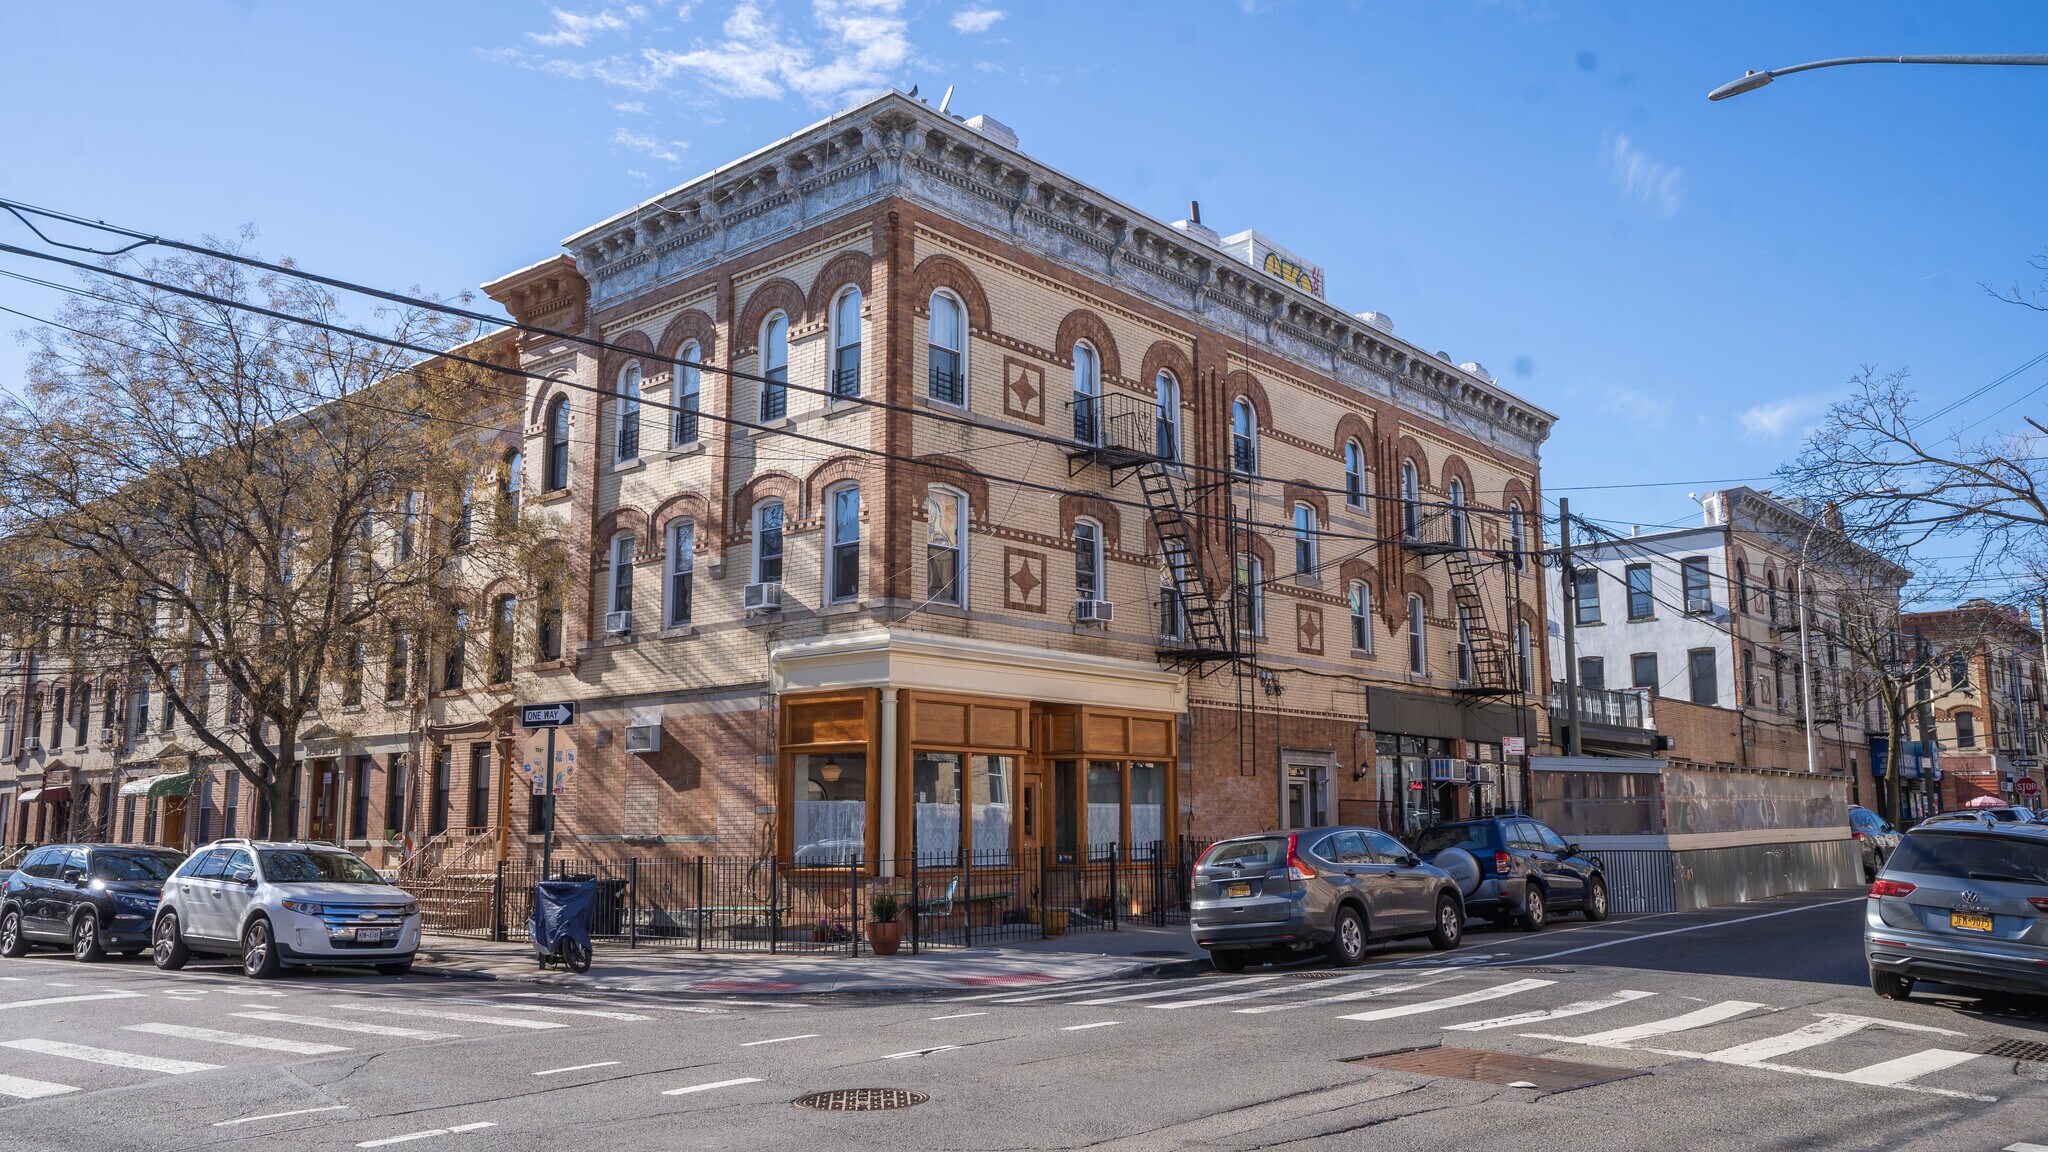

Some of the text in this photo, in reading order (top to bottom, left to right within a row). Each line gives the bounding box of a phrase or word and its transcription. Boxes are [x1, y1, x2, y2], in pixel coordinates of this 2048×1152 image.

[527, 710, 559, 720] ONE WAY
[2017, 783, 2037, 791] STOP
